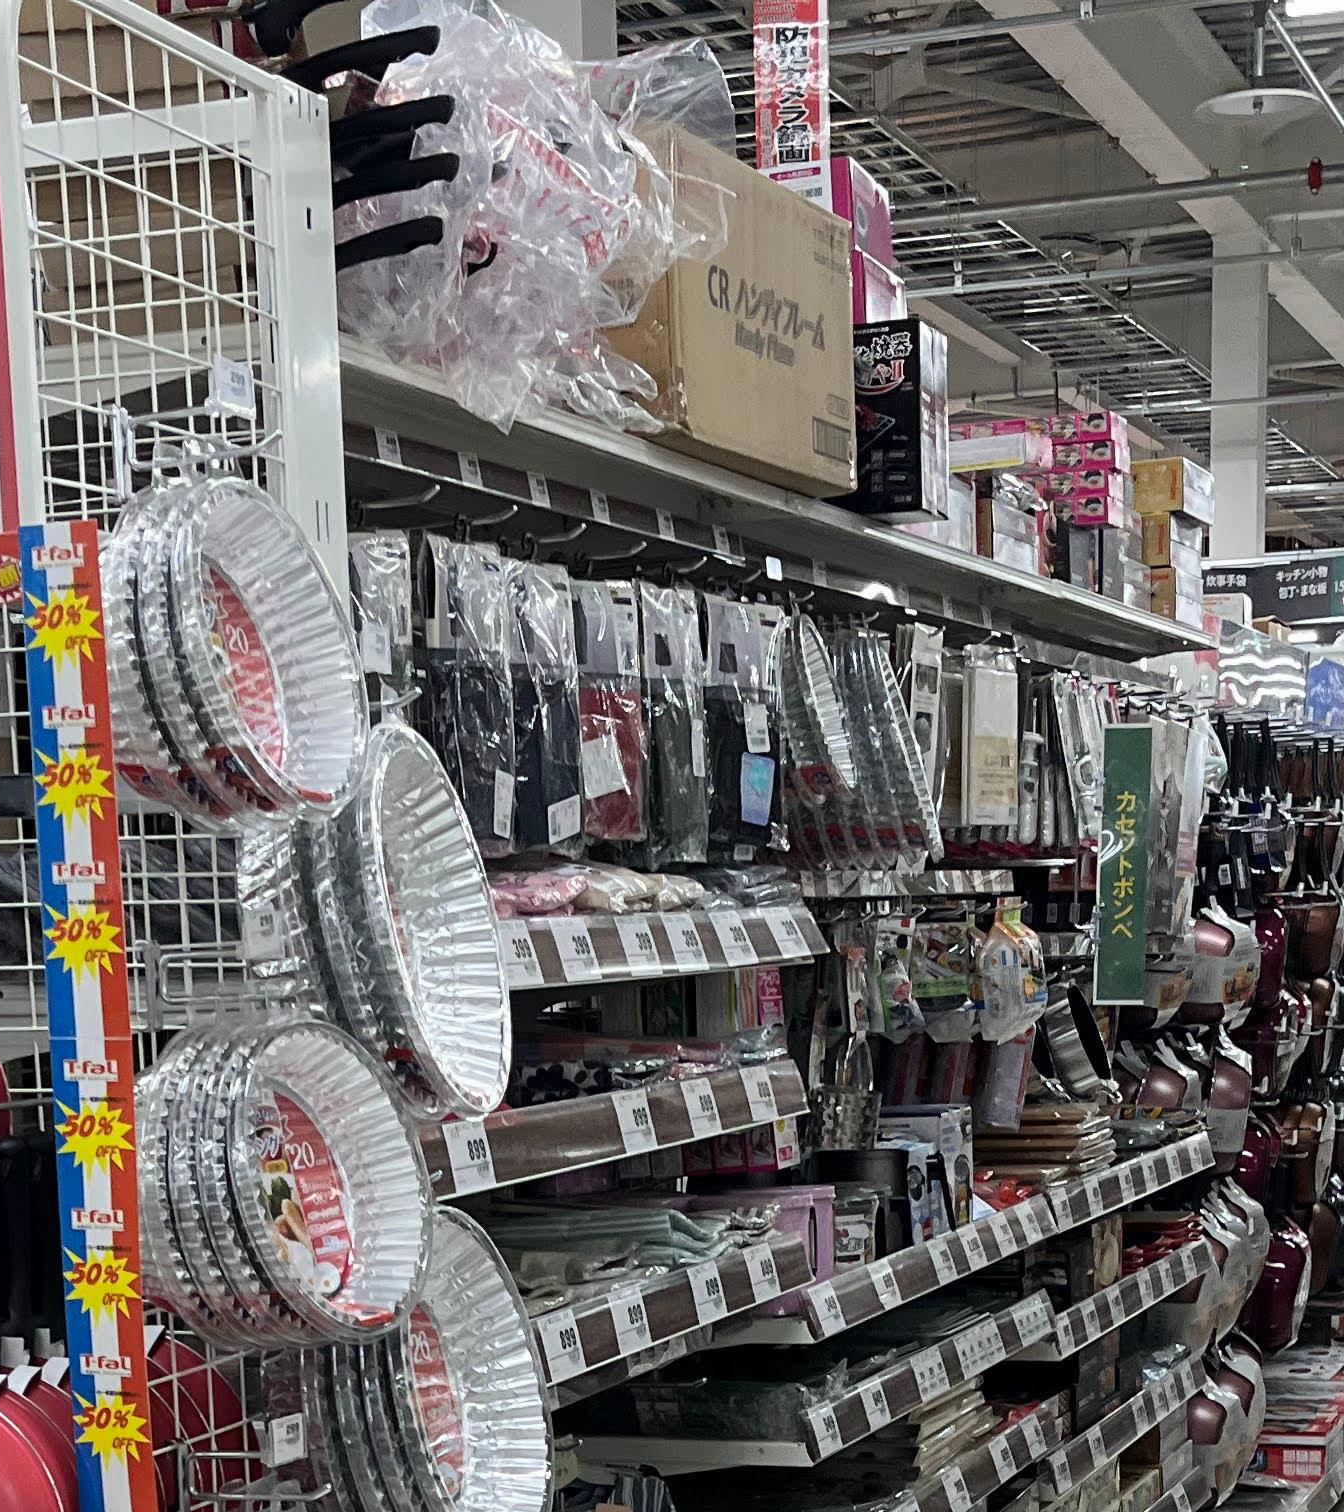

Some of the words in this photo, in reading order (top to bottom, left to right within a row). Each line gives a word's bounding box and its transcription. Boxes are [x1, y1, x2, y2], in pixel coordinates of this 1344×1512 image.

[708, 265, 729, 310] CR
[1206, 575, 1247, 588] 炊事手袋
[1276, 566, 1328, 583] キッチン小物
[1278, 585, 1328, 600] 包丁・まな板
[1333, 580, 1344, 593] 15
[33, 605, 81, 629] 50%
[224, 625, 248, 654] 20
[44, 764, 92, 788] 50%
[1112, 791, 1136, 938] カセットボンベ
[53, 920, 102, 943] 50%
[636, 932, 652, 950] 399
[513, 939, 532, 958] 399
[573, 935, 590, 955] 399
[64, 1116, 114, 1137] 50%
[292, 1141, 315, 1169] 20
[466, 1139, 487, 1160] 899
[71, 1262, 120, 1284] 50%
[628, 1304, 643, 1324] 899
[411, 1330, 430, 1363] 26
[560, 1328, 577, 1349] 899
[81, 1407, 129, 1429] 50%
